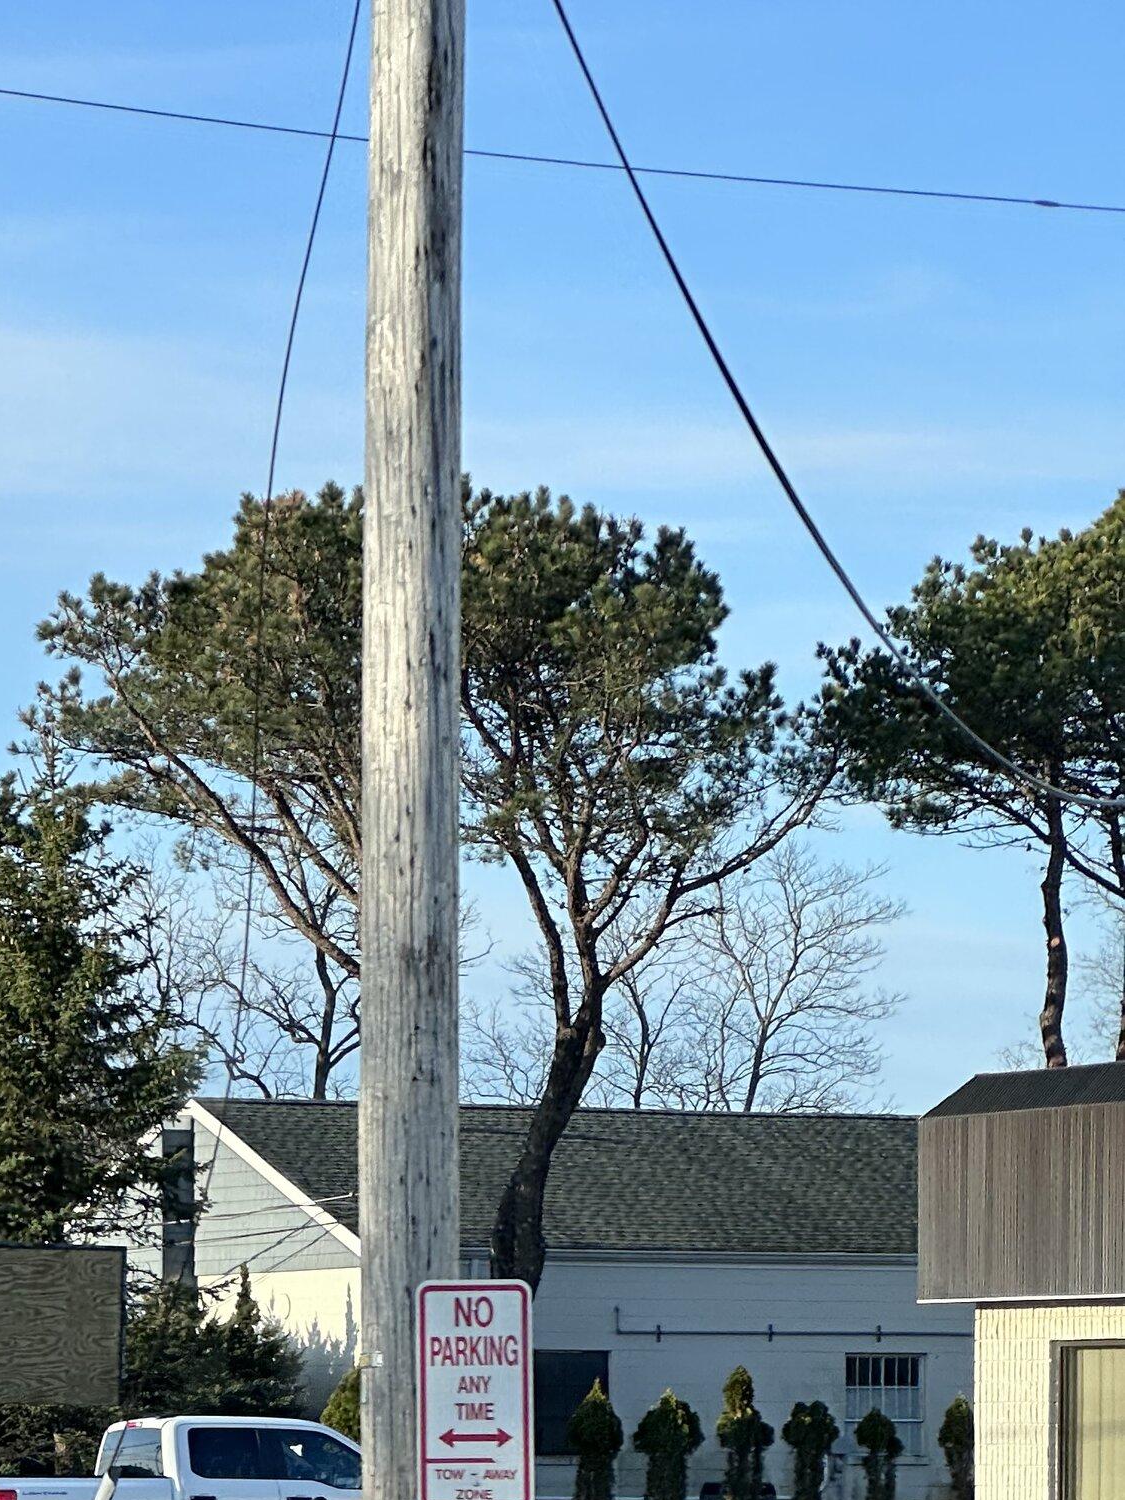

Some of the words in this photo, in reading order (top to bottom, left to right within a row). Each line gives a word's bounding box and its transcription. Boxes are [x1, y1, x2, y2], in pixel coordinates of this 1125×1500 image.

[454, 1296, 494, 1327] NO
[430, 1335, 519, 1366] PARKING
[457, 1376, 492, 1394] ANY
[455, 1403, 495, 1420] TIME
[455, 1490, 493, 1500] ZONE
